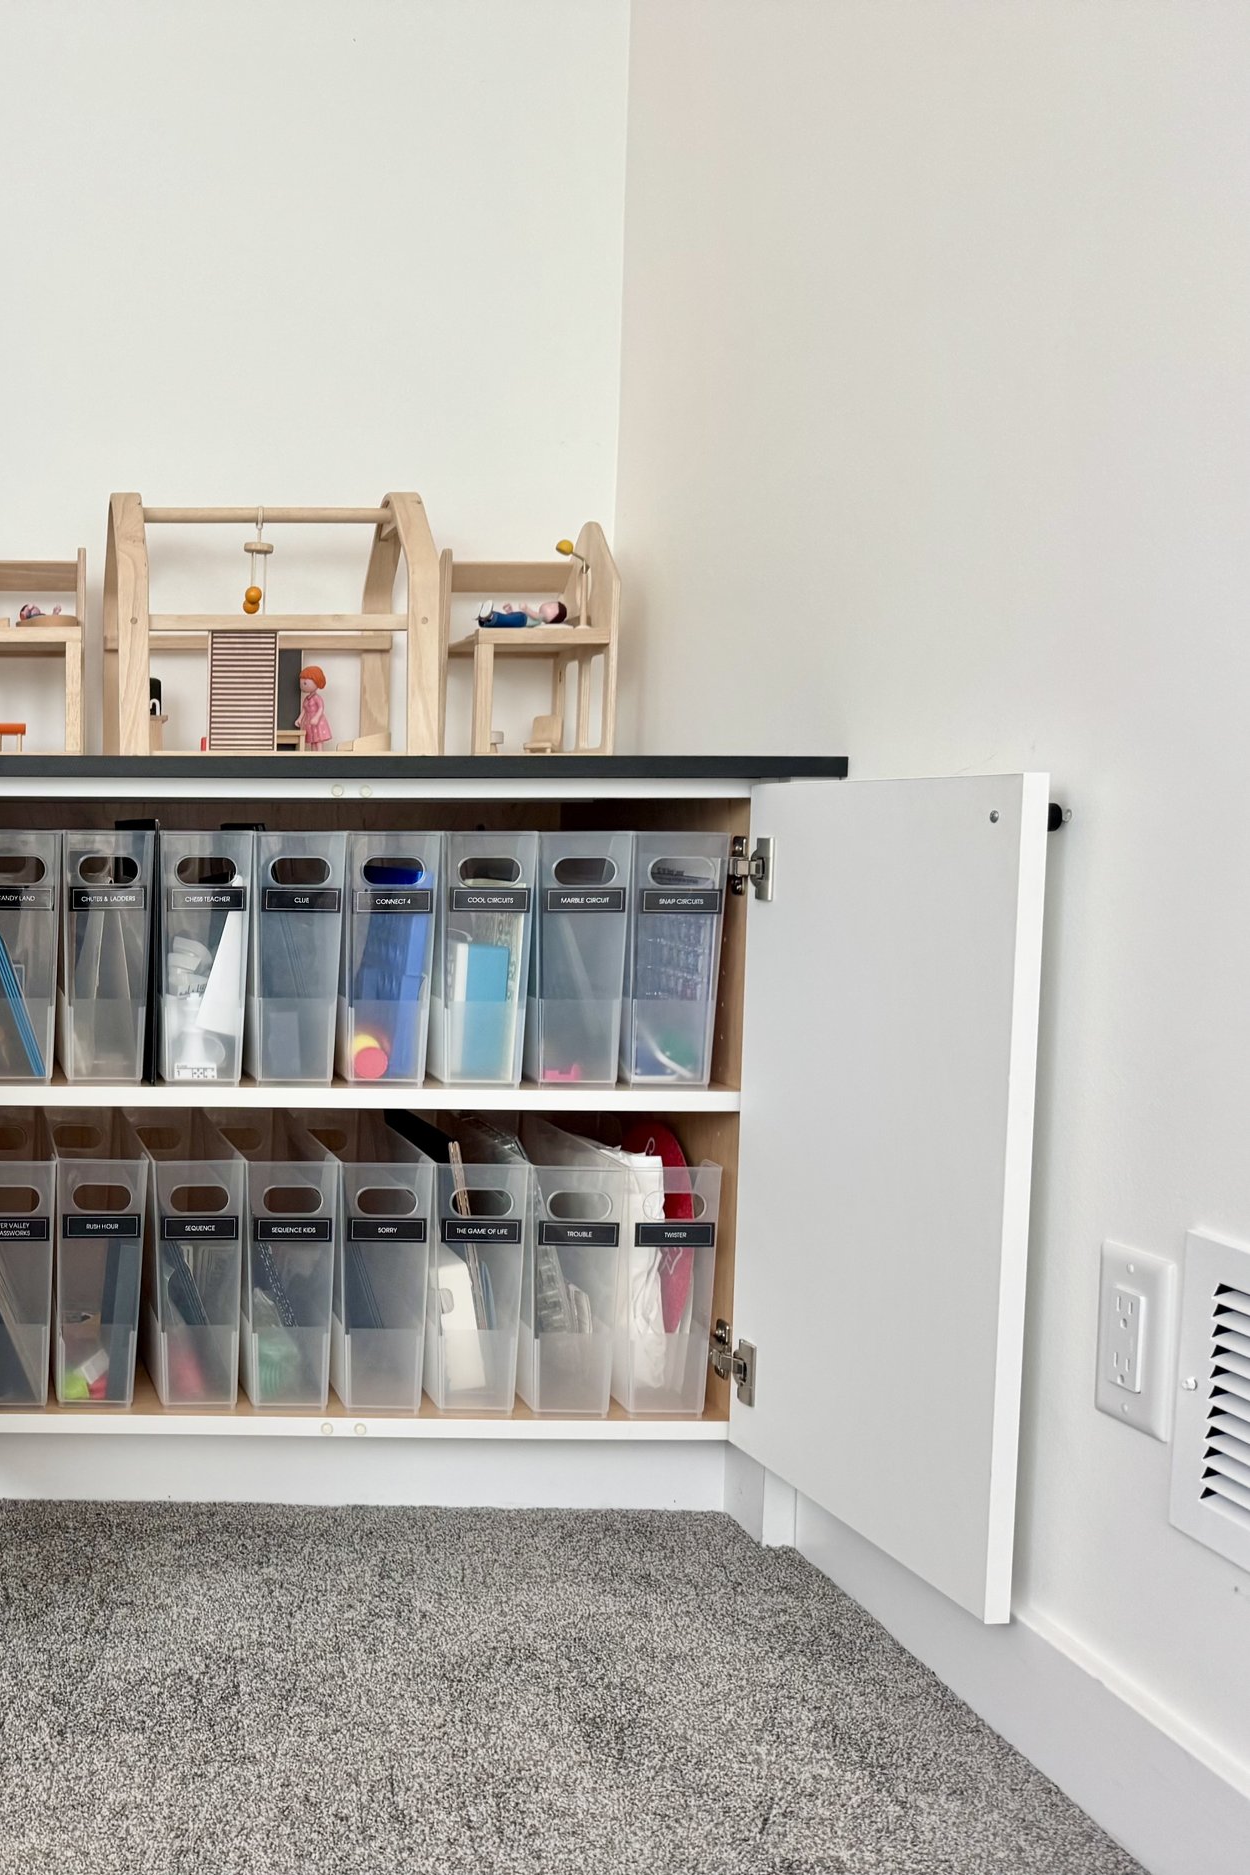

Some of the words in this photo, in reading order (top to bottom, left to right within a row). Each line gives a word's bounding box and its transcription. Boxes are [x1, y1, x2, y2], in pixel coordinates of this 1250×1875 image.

[18, 894, 36, 902] LAND
[80, 895, 102, 903] CHUTES
[103, 895, 109, 903] &
[110, 895, 136, 903] LADDERS
[184, 895, 203, 904] CHESS
[204, 895, 231, 904] TEACHER
[294, 896, 310, 904] CLUE
[375, 897, 406, 905] CONNECT
[467, 896, 486, 904] COOL
[486, 896, 514, 904] CIRCUITS
[560, 896, 586, 904] MARBLE
[586, 896, 610, 904] CIRCUIT
[8, 1222, 30, 1230] VALLEY
[184, 1224, 216, 1232] SEQUENCE
[271, 1226, 302, 1234] SEQUENCE
[303, 1226, 316, 1234] KIDS
[377, 1226, 398, 1234] SORRY
[456, 1227, 467, 1235] THE
[467, 1227, 486, 1235] GAME
[567, 1230, 593, 1238] TROUBLE
[664, 1231, 687, 1239] TWISTER
